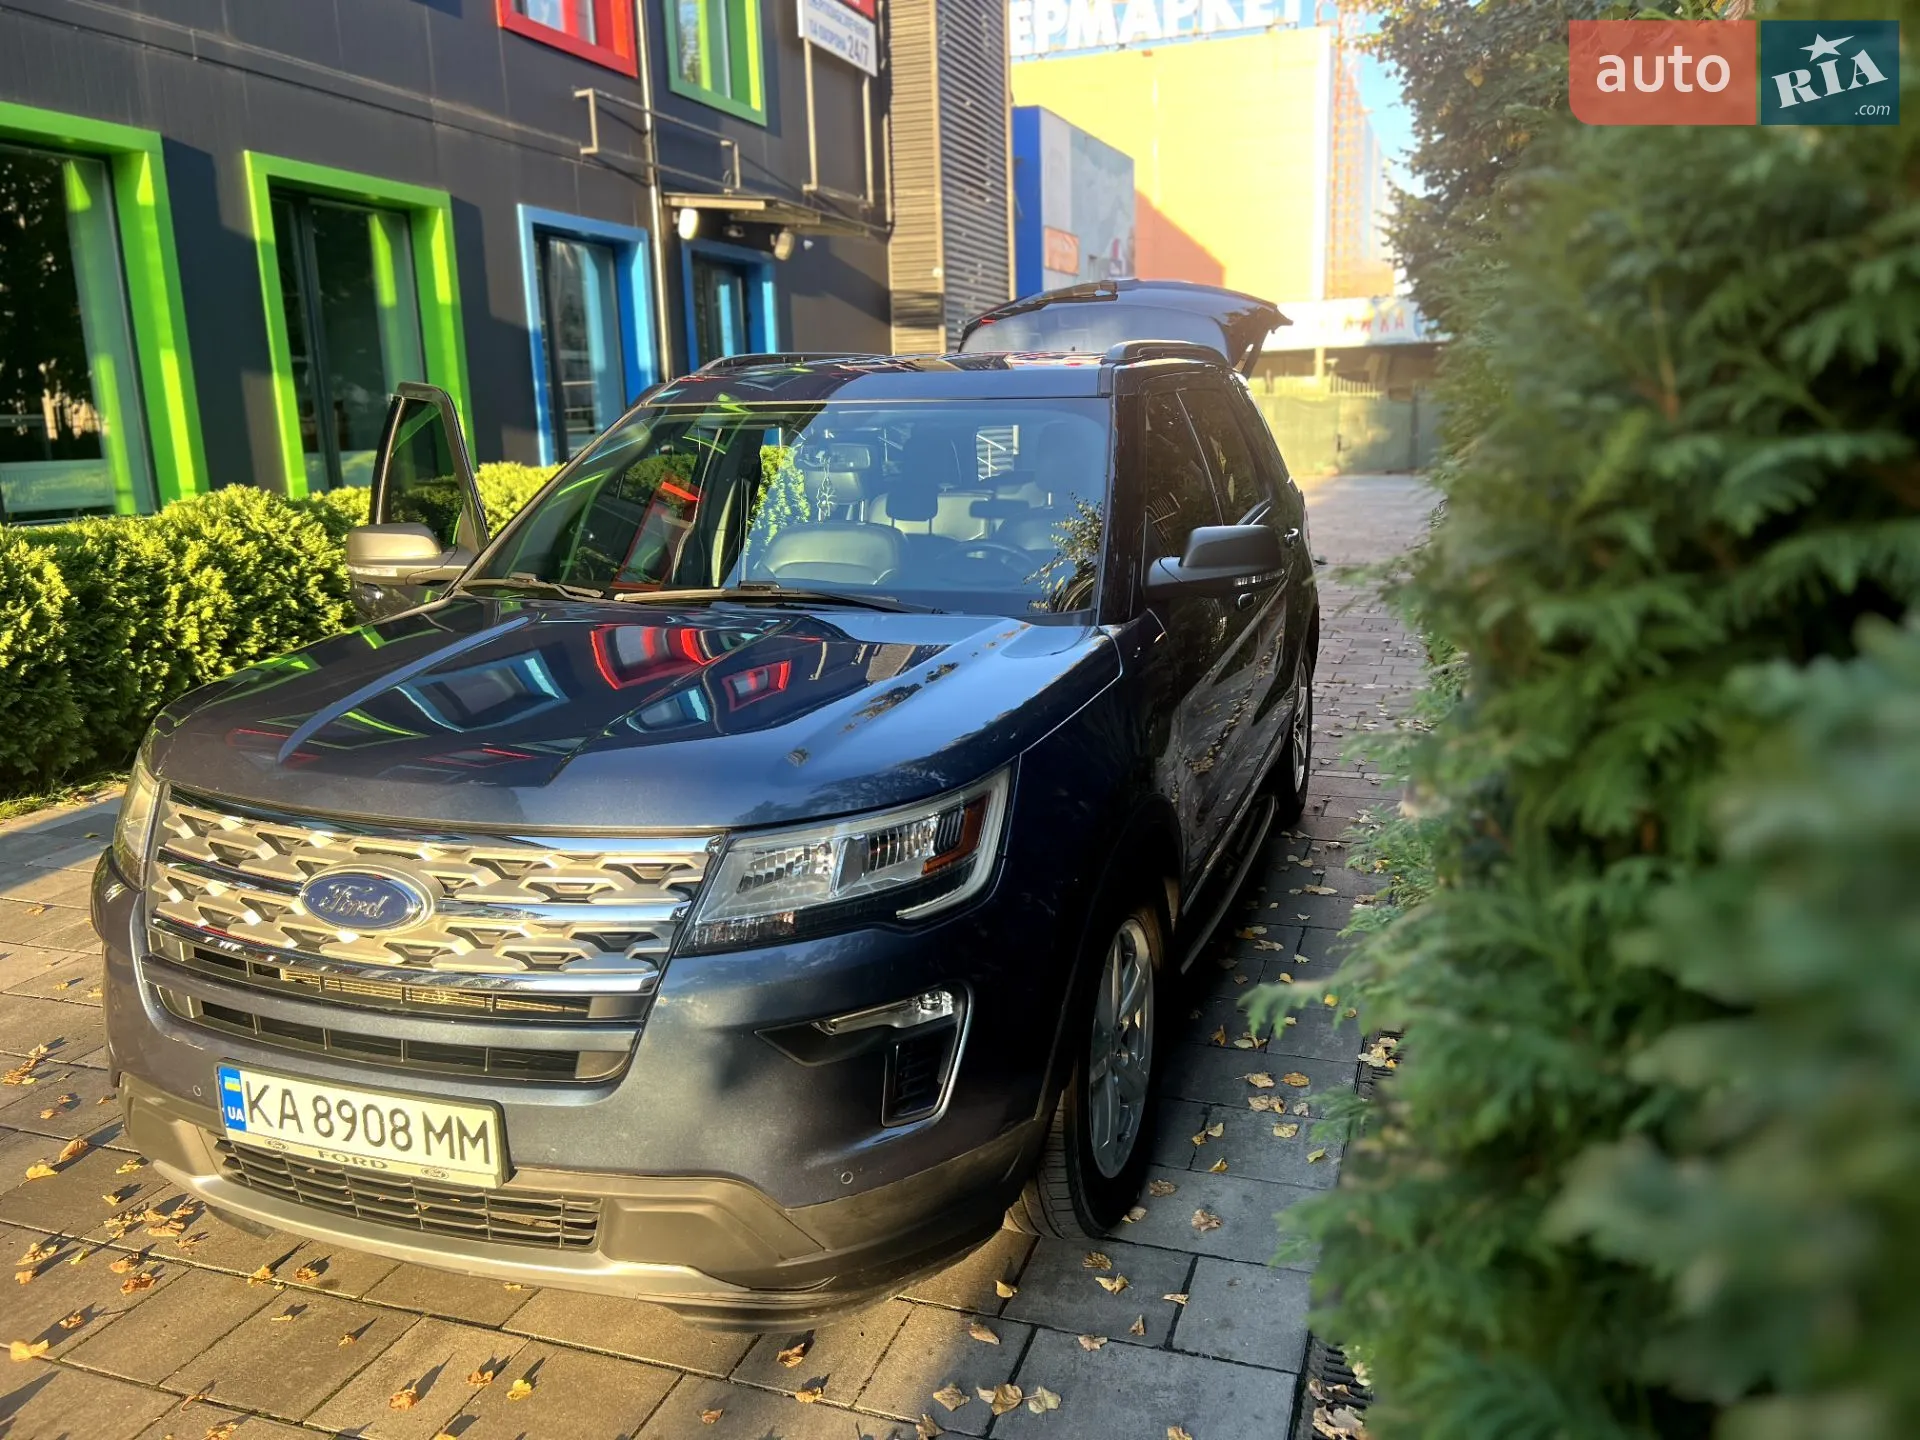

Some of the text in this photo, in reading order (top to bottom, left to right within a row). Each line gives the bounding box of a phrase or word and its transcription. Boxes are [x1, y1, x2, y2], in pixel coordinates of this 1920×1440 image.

[318, 884, 389, 919] Ford
[228, 1106, 244, 1121] UA
[246, 1080, 491, 1165] KA 8908 MM
[318, 1150, 388, 1170] FORD
